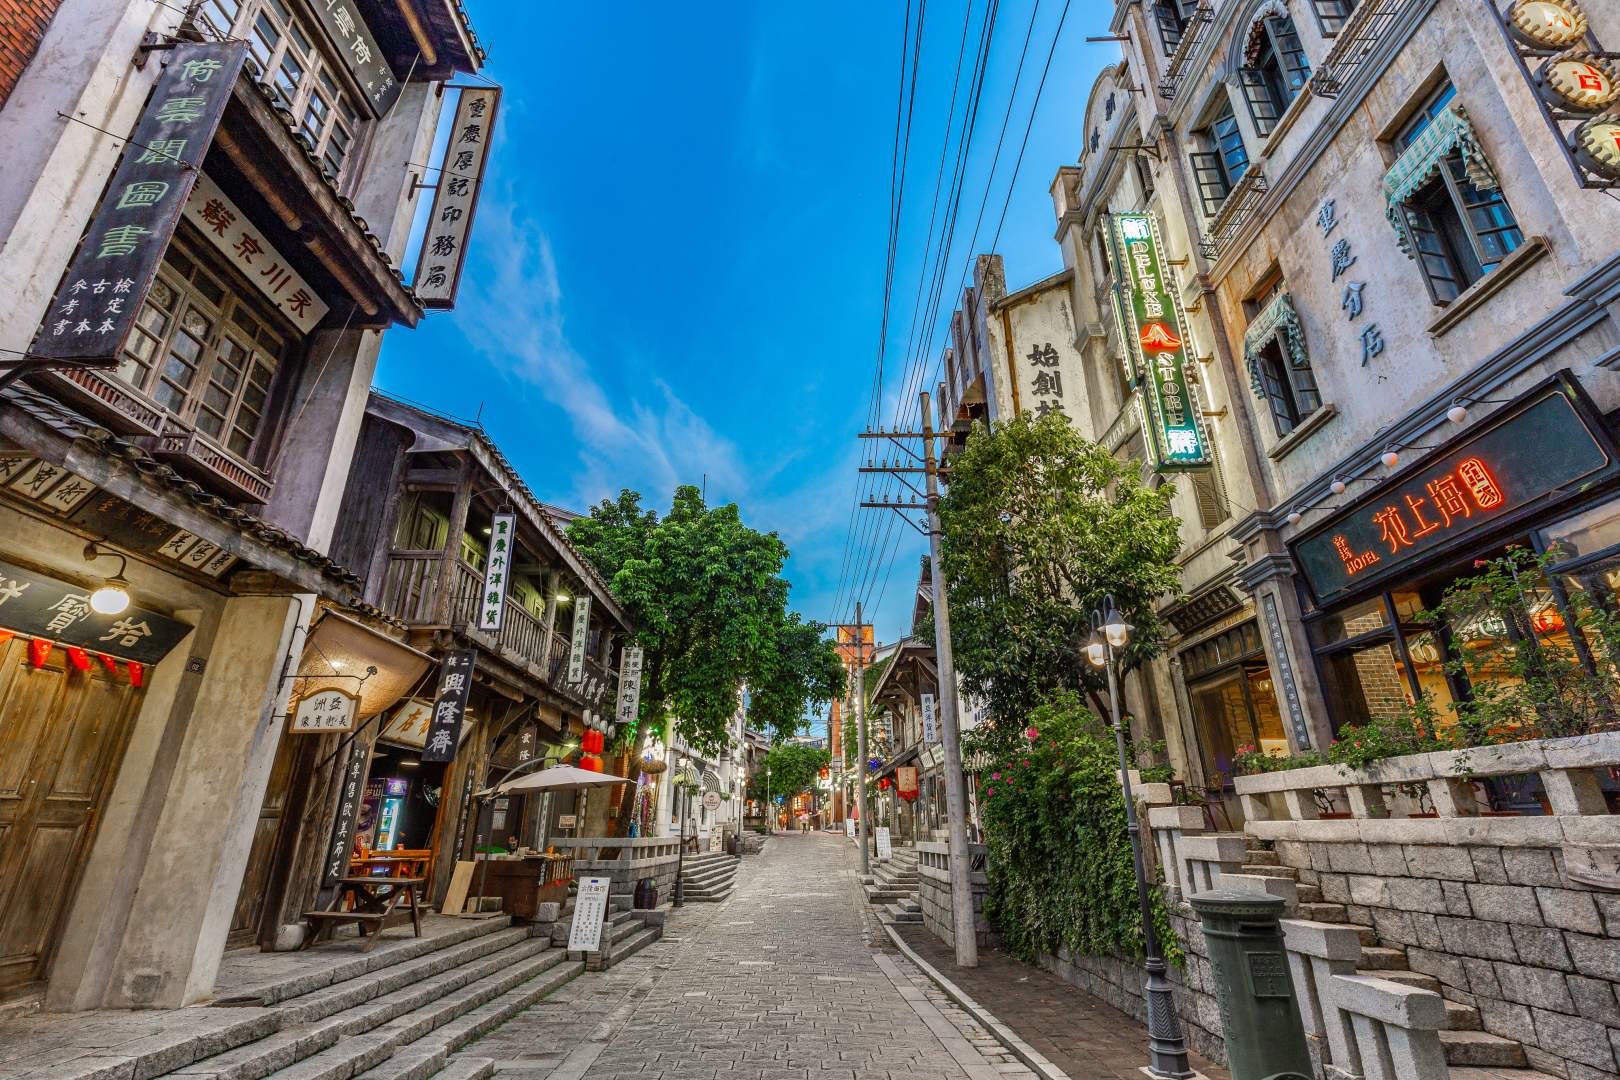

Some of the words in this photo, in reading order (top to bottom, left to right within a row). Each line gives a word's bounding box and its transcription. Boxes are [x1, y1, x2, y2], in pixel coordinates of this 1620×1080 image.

[326, 0, 371, 65] 倚雲
[422, 98, 486, 288] 重慶厚記印務局
[188, 176, 312, 318] 永川京蘇
[1131, 241, 1163, 318] DELUXE
[1157, 352, 1184, 426] STORE
[1346, 551, 1380, 575] HOTEL
